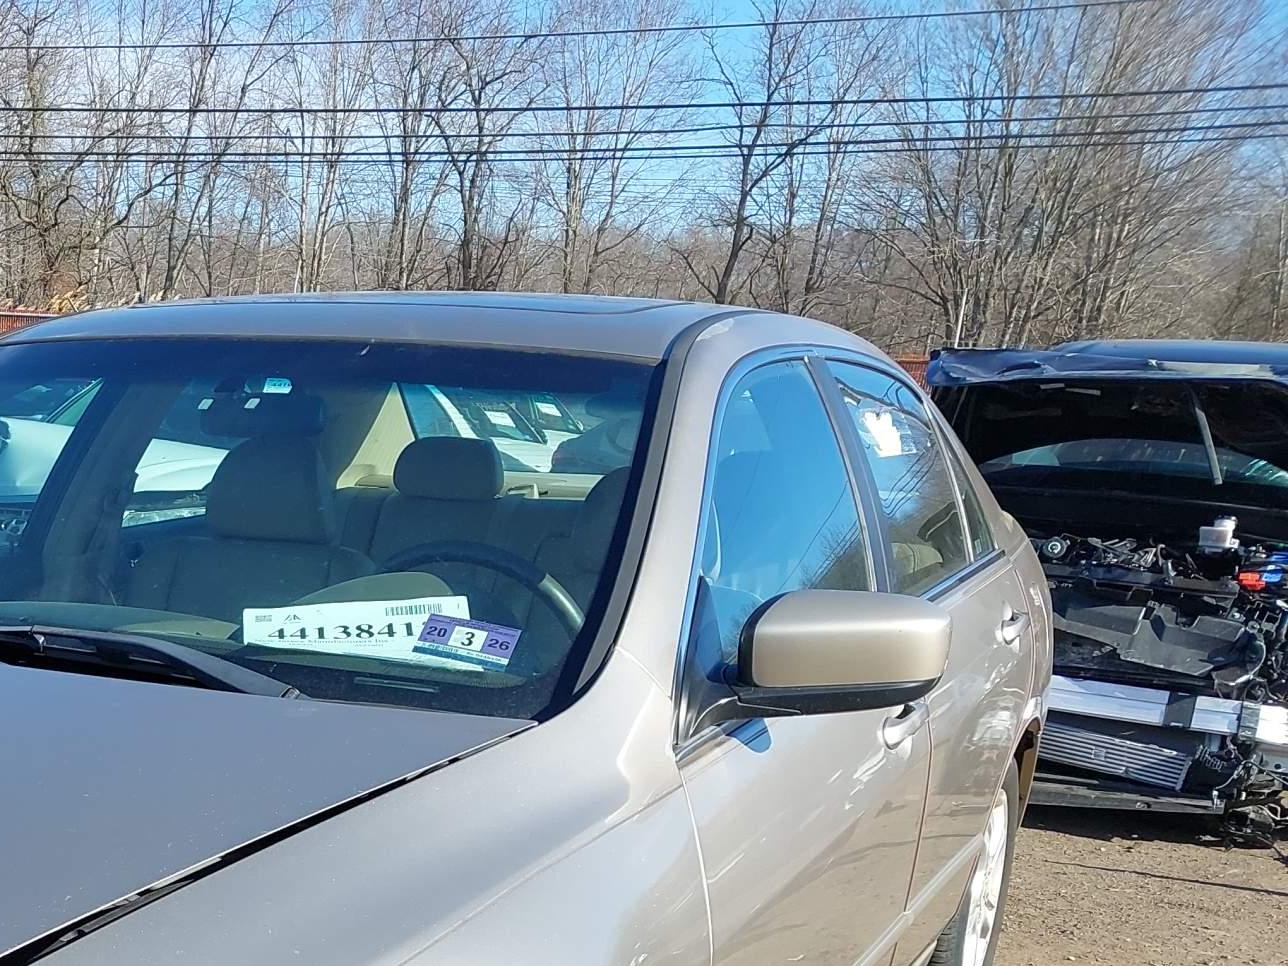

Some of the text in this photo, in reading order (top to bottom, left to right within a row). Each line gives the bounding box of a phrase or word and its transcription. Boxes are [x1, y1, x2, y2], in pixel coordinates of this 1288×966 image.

[267, 621, 427, 640] 4413841
[426, 625, 448, 638] 20
[460, 631, 476, 647] 3
[487, 638, 511, 651] 26
